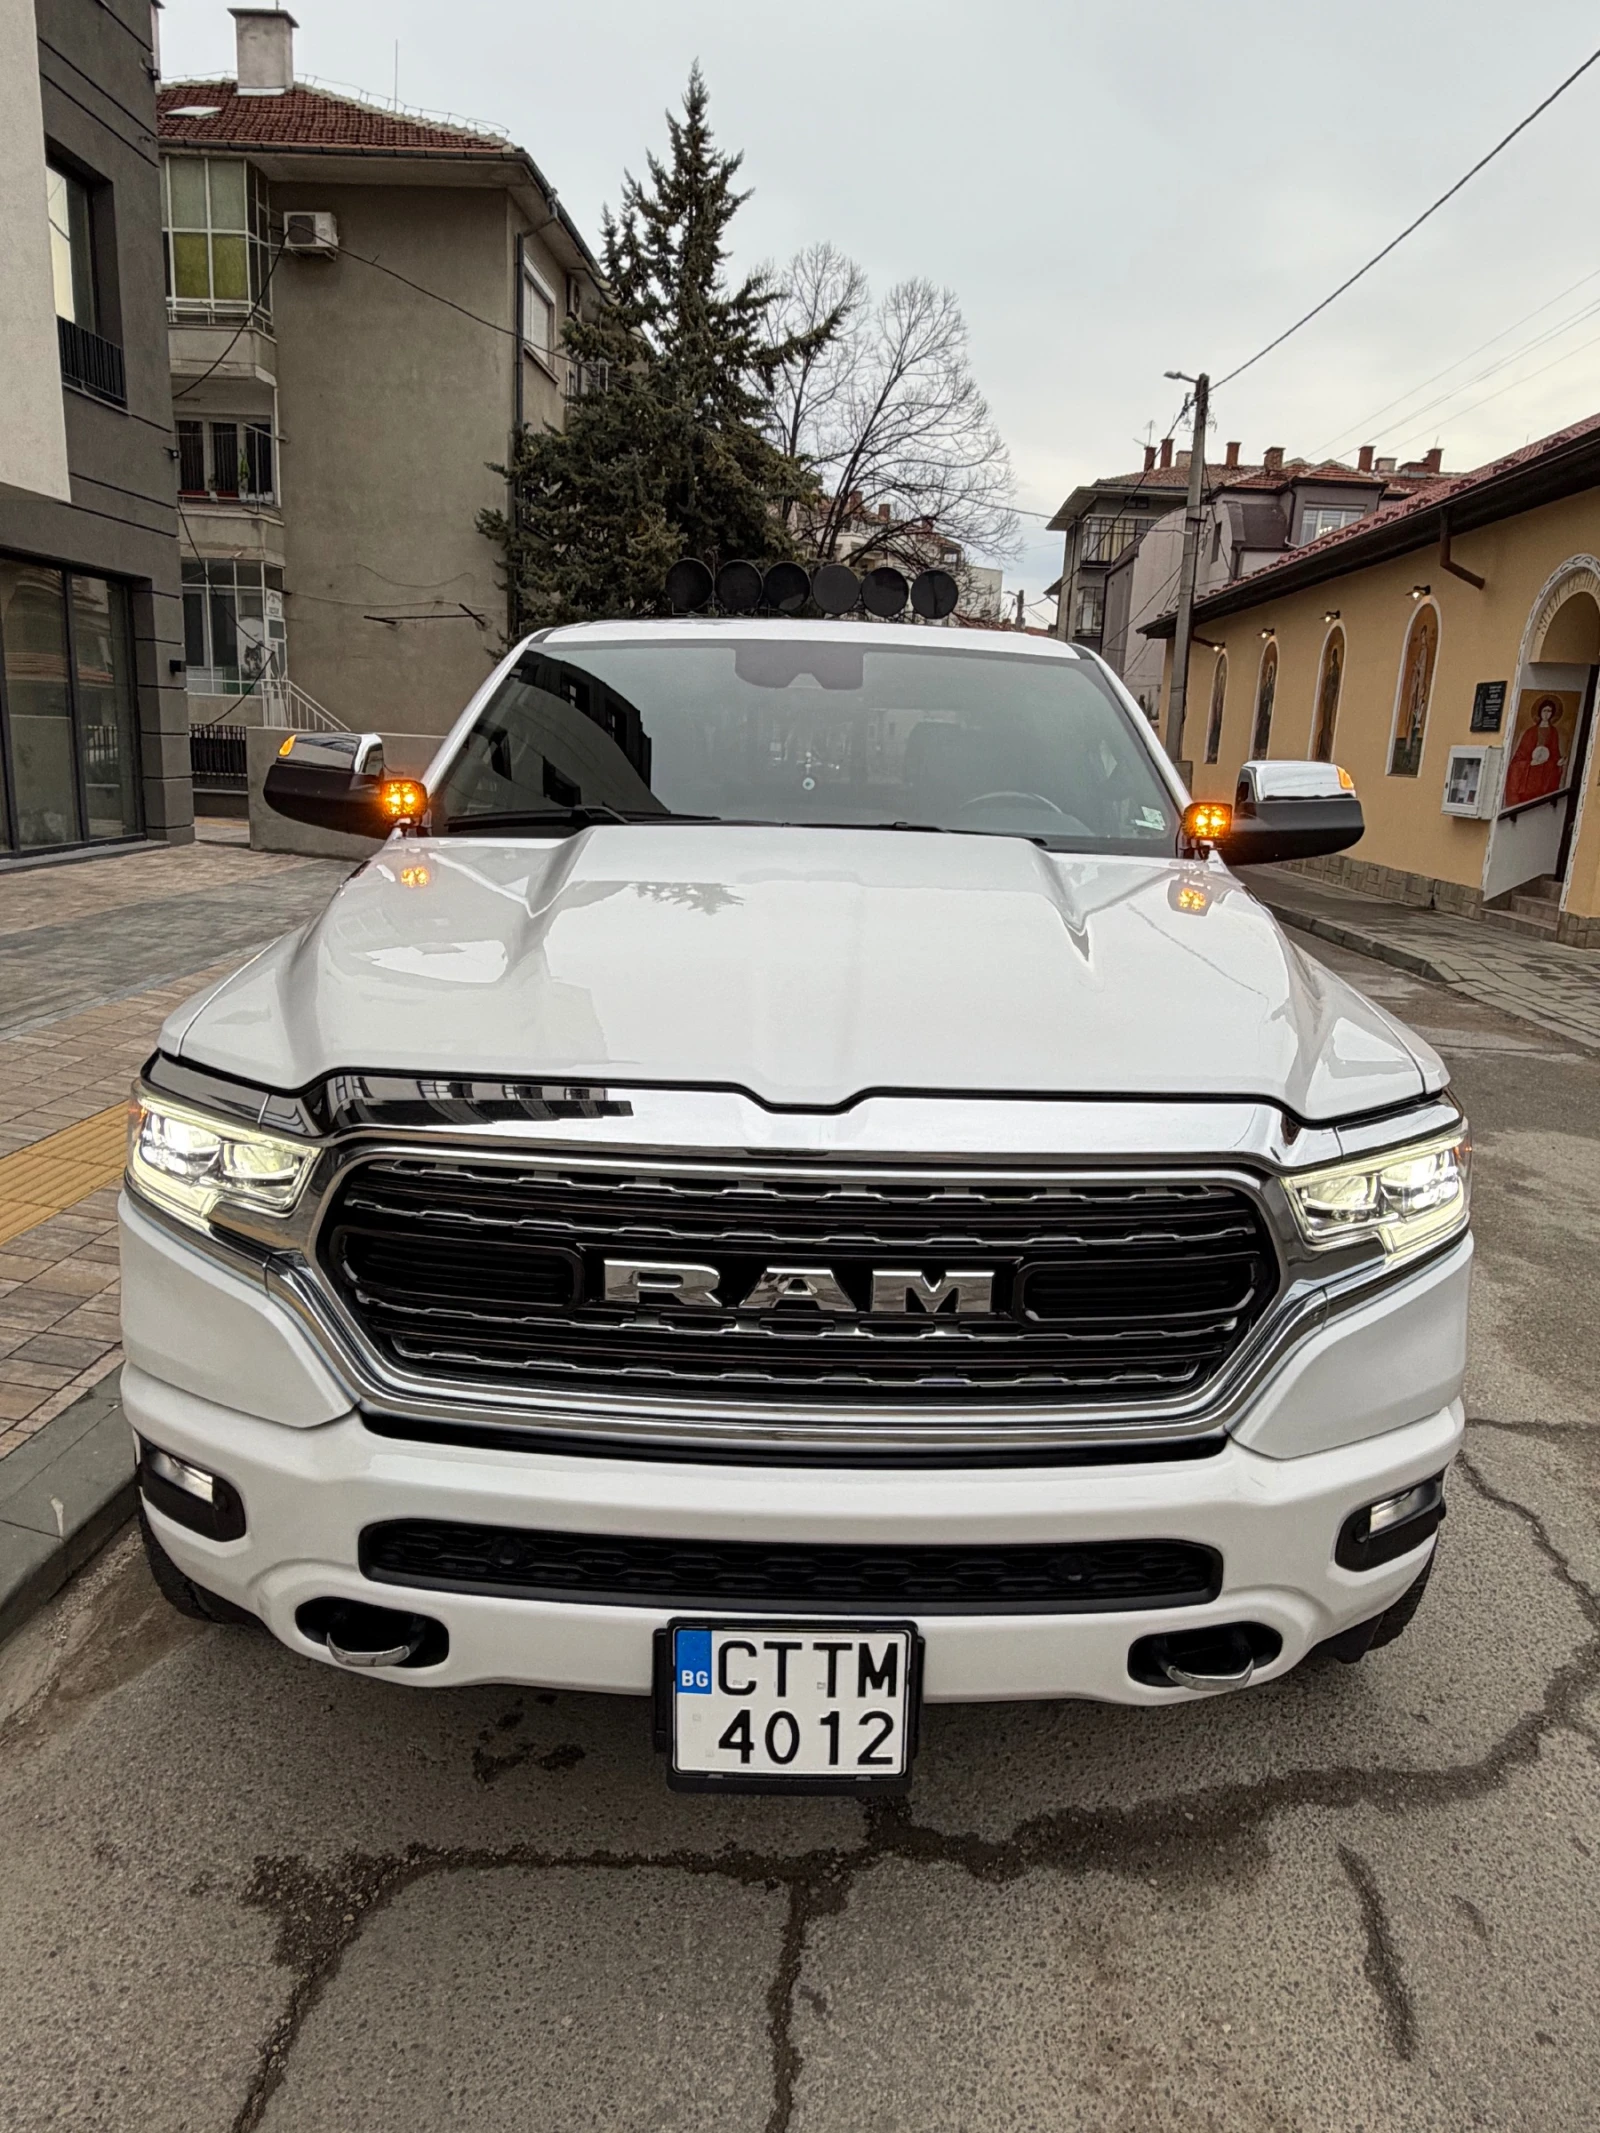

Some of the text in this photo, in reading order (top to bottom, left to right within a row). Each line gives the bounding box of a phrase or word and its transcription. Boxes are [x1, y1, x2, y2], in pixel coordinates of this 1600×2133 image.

[603, 1259, 995, 1314] RAM
[681, 1670, 708, 1688] BG
[718, 1709, 895, 1766] 4012
